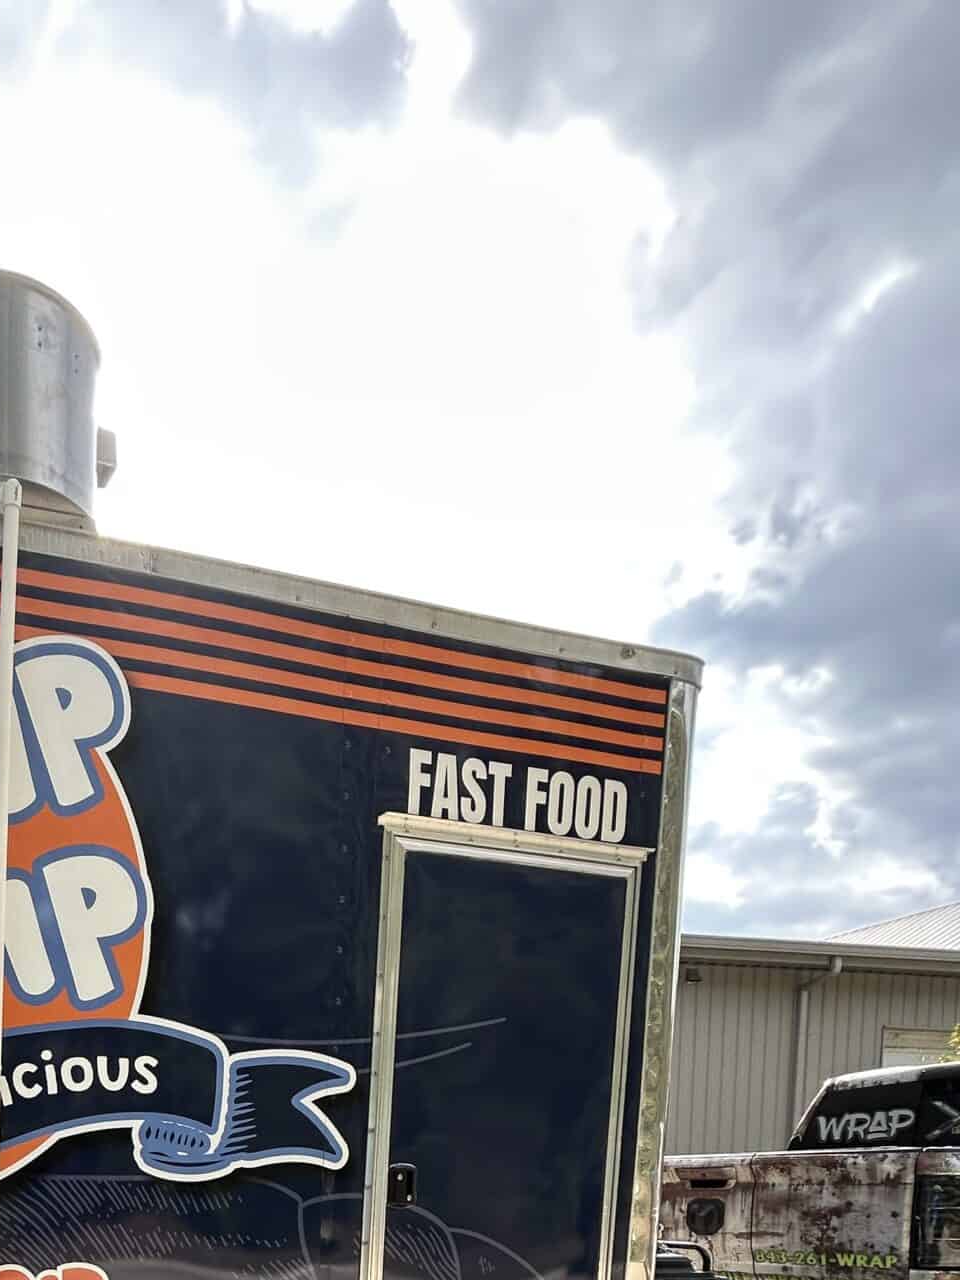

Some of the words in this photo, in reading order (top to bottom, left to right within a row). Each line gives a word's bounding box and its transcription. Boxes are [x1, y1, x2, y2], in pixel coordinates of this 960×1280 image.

[407, 747, 512, 826] FAST
[524, 766, 628, 843] FOOD
[817, 1108, 915, 1141] WRAP
